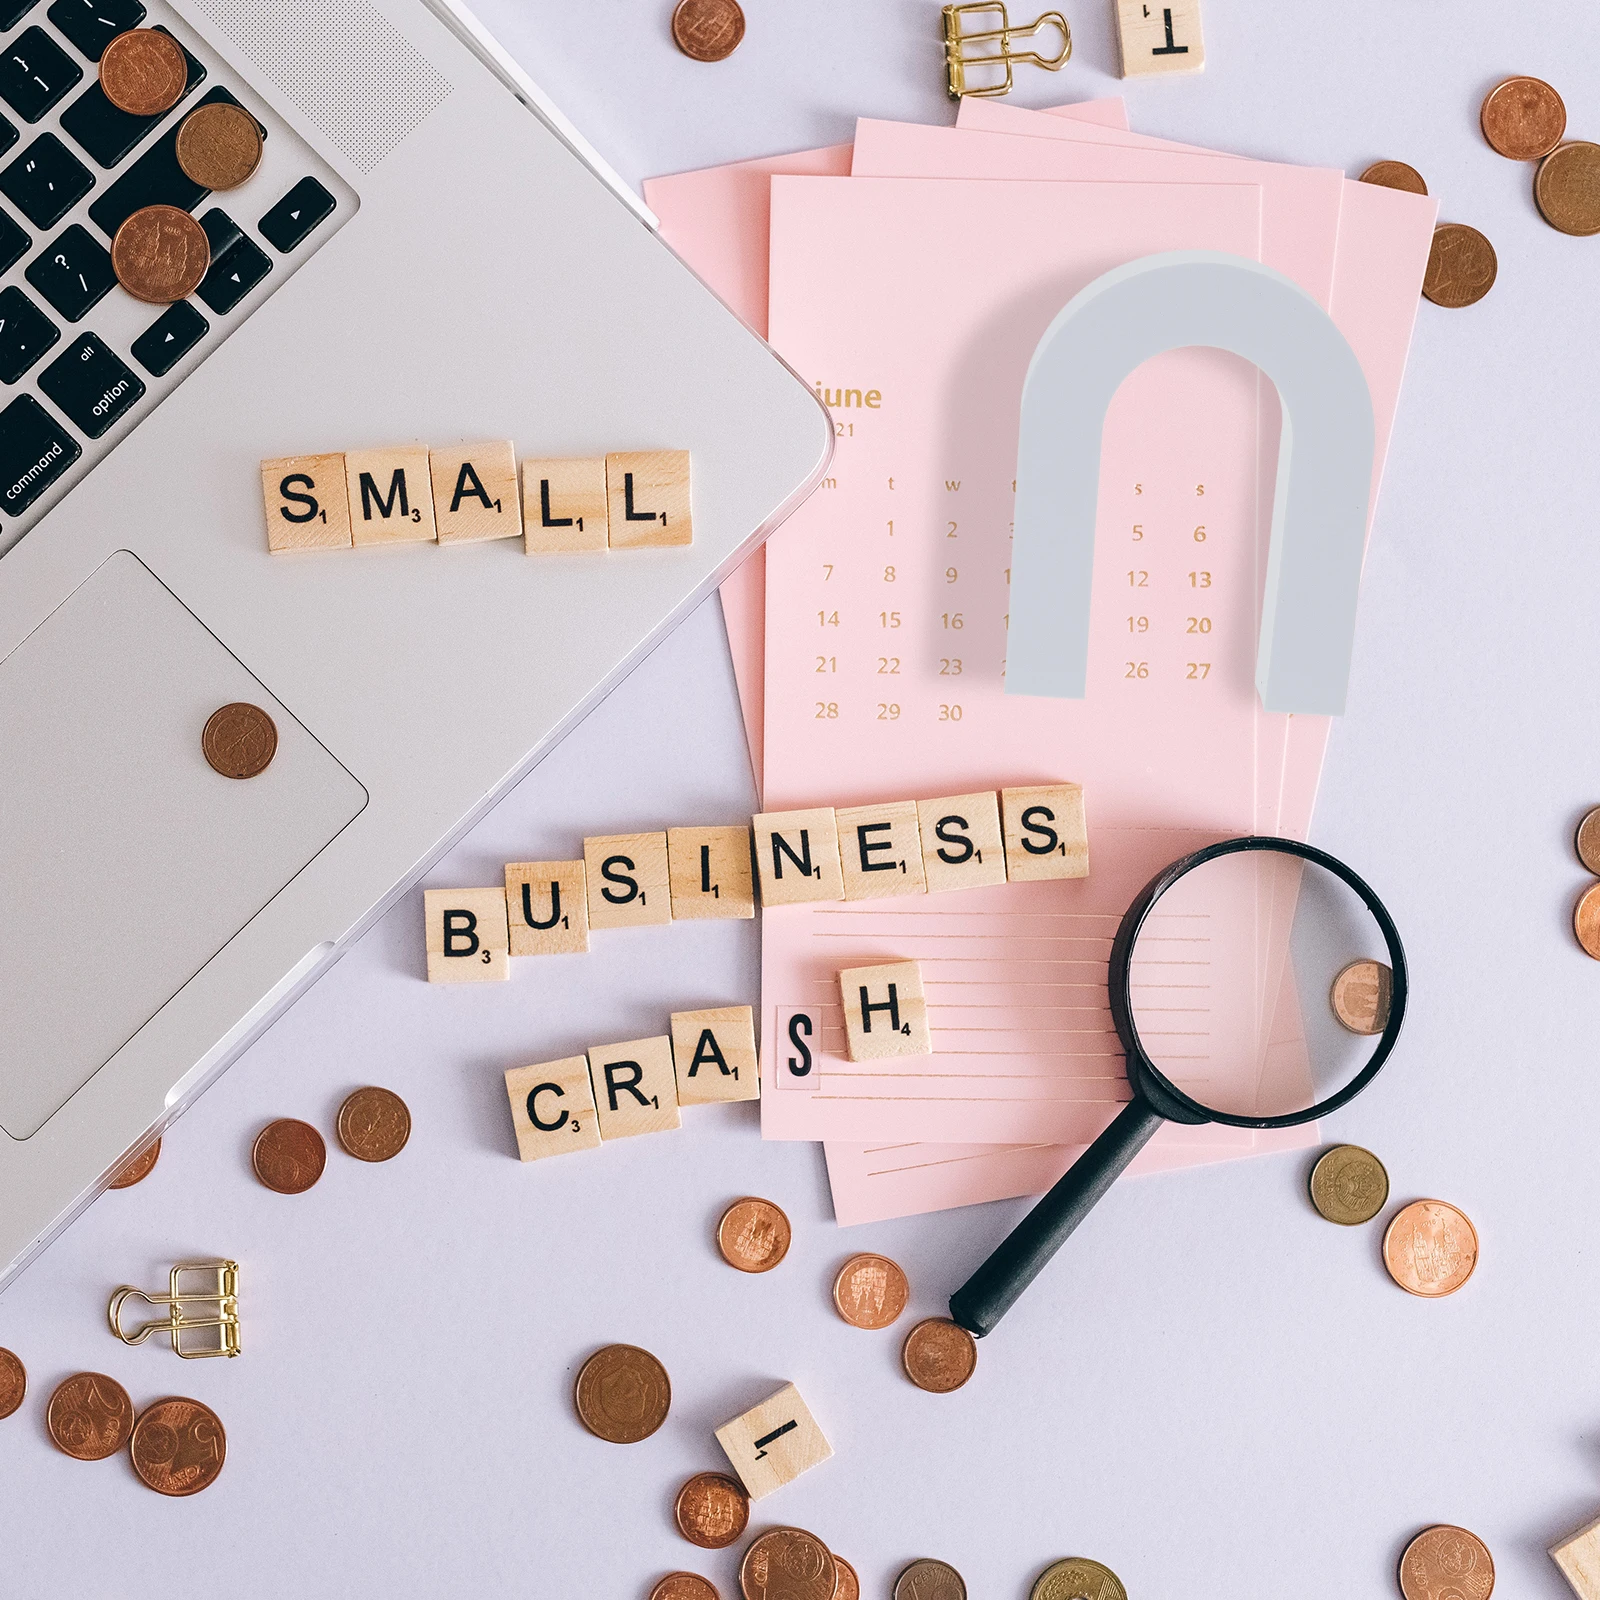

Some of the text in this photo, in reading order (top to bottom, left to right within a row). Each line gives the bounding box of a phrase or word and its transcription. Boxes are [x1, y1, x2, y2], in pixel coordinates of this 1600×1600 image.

[1152, 8, 1188, 55] T
[80, 346, 95, 362] alt
[92, 380, 129, 416] option
[836, 422, 854, 437] 21
[6, 442, 63, 500] command
[280, 463, 657, 526] SMALL
[887, 477, 895, 491] t
[945, 481, 961, 492] w
[1135, 483, 1143, 496] s
[1195, 483, 1204, 497] s
[886, 520, 1207, 543] 1 2 5 6
[823, 564, 834, 581] 7
[883, 565, 897, 583] 8
[946, 567, 959, 584] 9
[1127, 570, 1150, 588] 12
[1187, 570, 1213, 589] 13
[817, 610, 840, 628] 14
[879, 611, 902, 629] 15
[941, 613, 964, 630] 16
[1127, 616, 1150, 633] 19
[1185, 616, 1213, 634] 20
[815, 655, 1212, 680] 21 22 23 26 27
[815, 702, 963, 721] 28 29 30
[444, 806, 1057, 957] BUSINESS
[527, 984, 899, 1131] CRASH
[187, 1417, 220, 1461] 5
